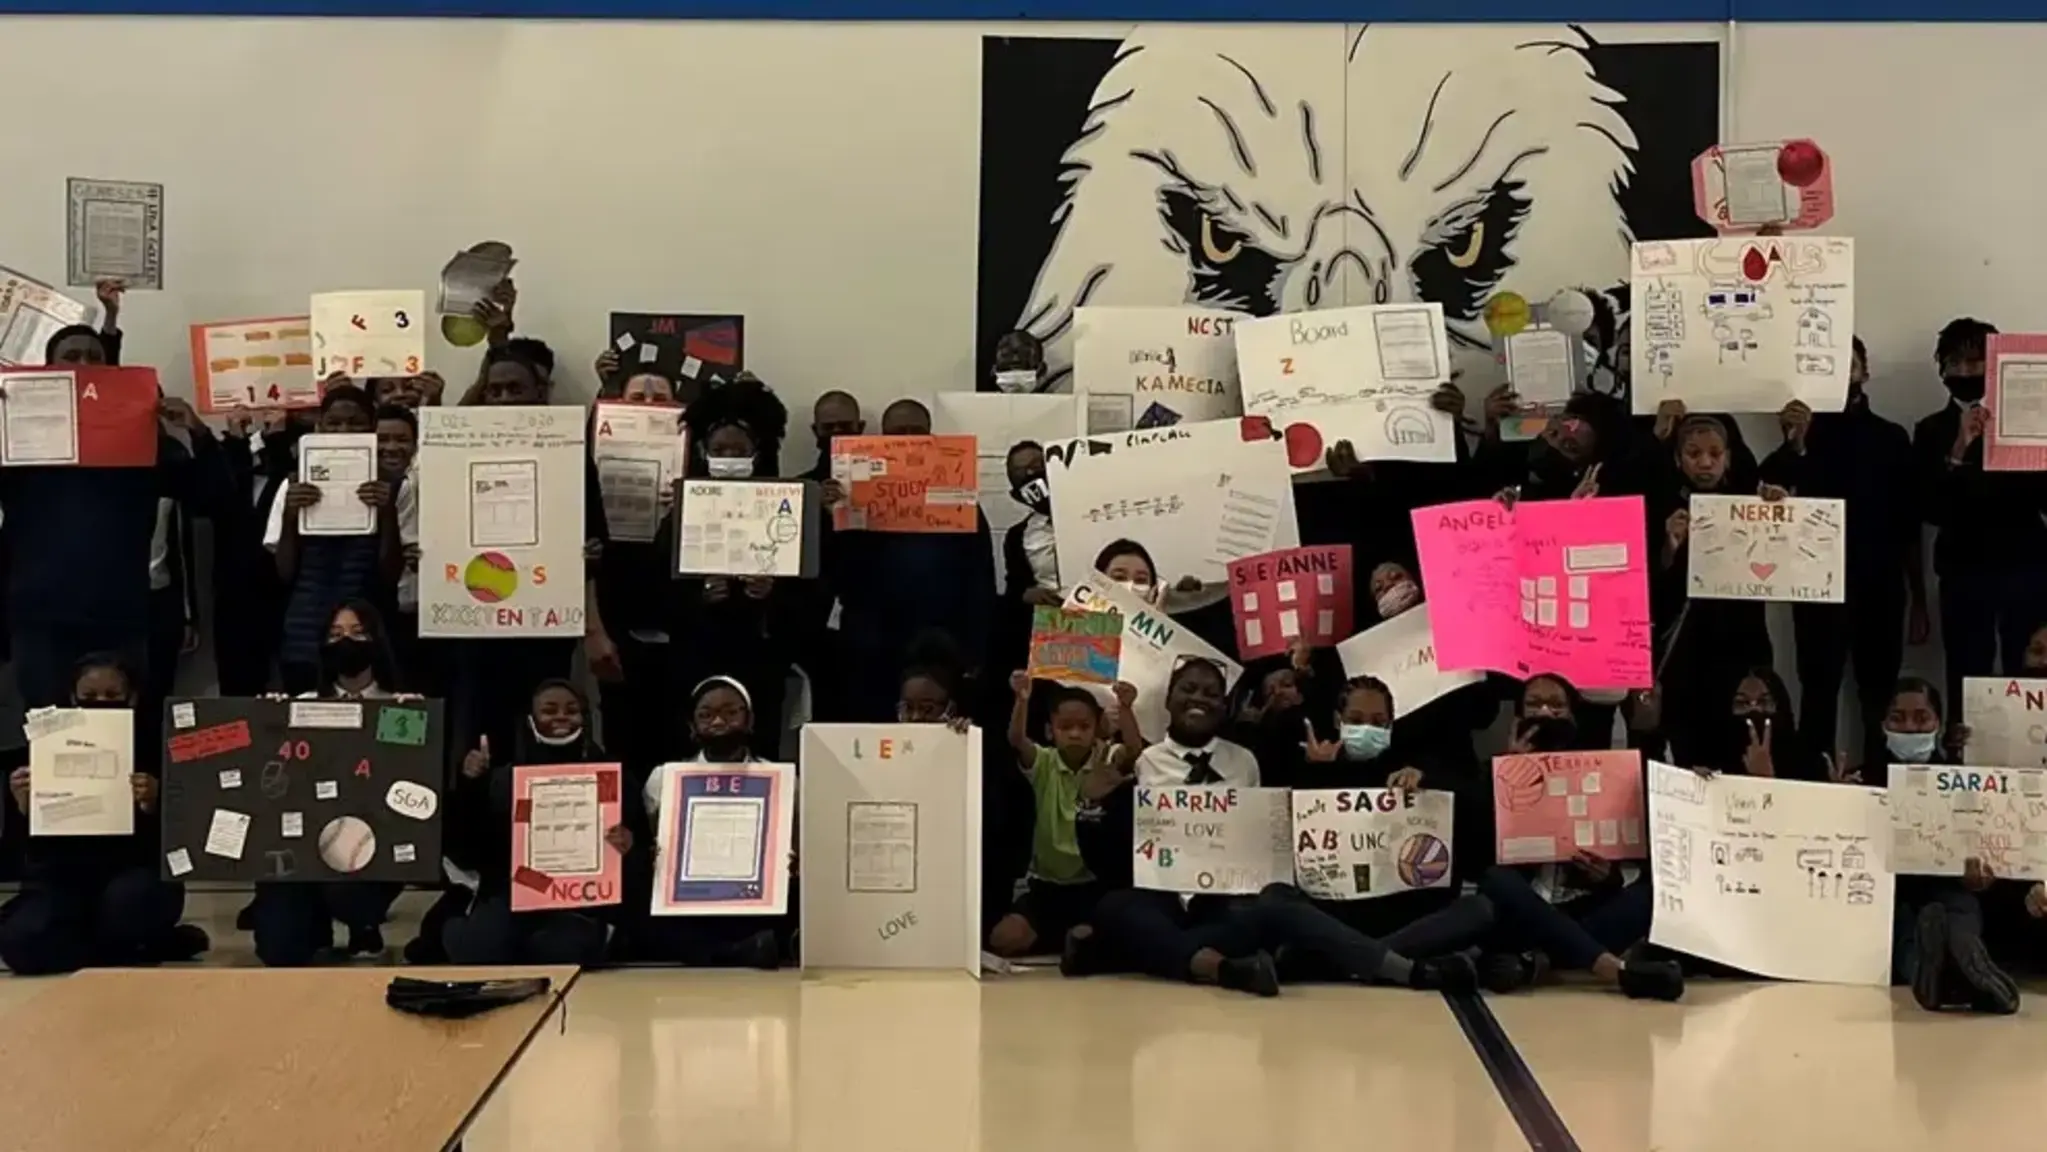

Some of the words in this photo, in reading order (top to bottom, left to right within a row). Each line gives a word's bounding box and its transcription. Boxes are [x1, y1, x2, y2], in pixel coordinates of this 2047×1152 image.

[1289, 319, 1349, 345] Board
[82, 383, 98, 400] A
[1135, 376, 1225, 395] KAMECIA
[599, 421, 612, 436] A
[1730, 504, 1795, 523] NERRI
[1937, 772, 2008, 794] SARAI
[393, 788, 431, 810] SGA
[1137, 788, 1238, 813] KARRINE
[1336, 791, 1416, 812] SAGE
[1184, 822, 1225, 837] LOVE
[552, 881, 613, 901] NCCU
[878, 910, 919, 941] LOVE
